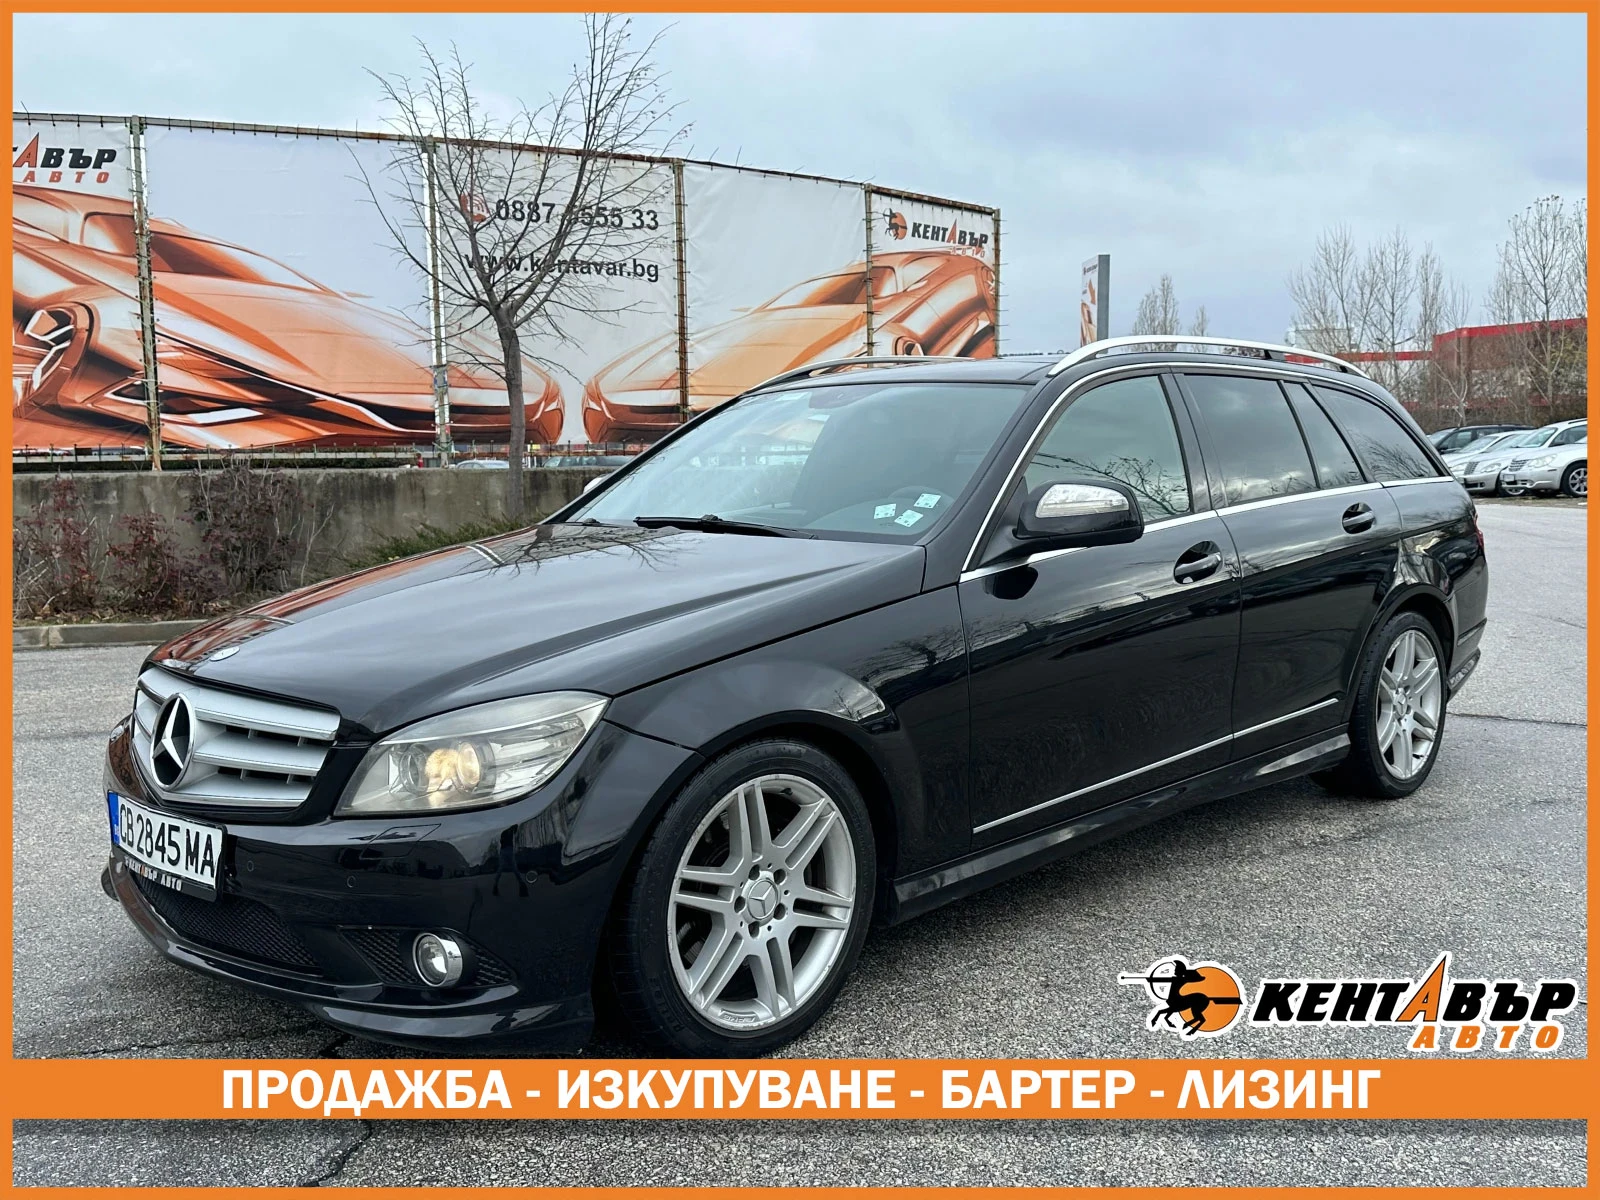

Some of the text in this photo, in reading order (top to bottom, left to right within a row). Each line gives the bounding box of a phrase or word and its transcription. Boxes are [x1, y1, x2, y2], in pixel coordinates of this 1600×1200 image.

[12, 132, 117, 169] АВЪР
[22, 170, 110, 184] АВТО
[495, 199, 556, 223] 0887
[631, 208, 659, 230] 33
[911, 217, 989, 248] КЕНТАВЪР
[465, 251, 659, 283] www.kntavar.bg
[136, 813, 181, 867] 2845
[160, 874, 182, 892] АВТО
